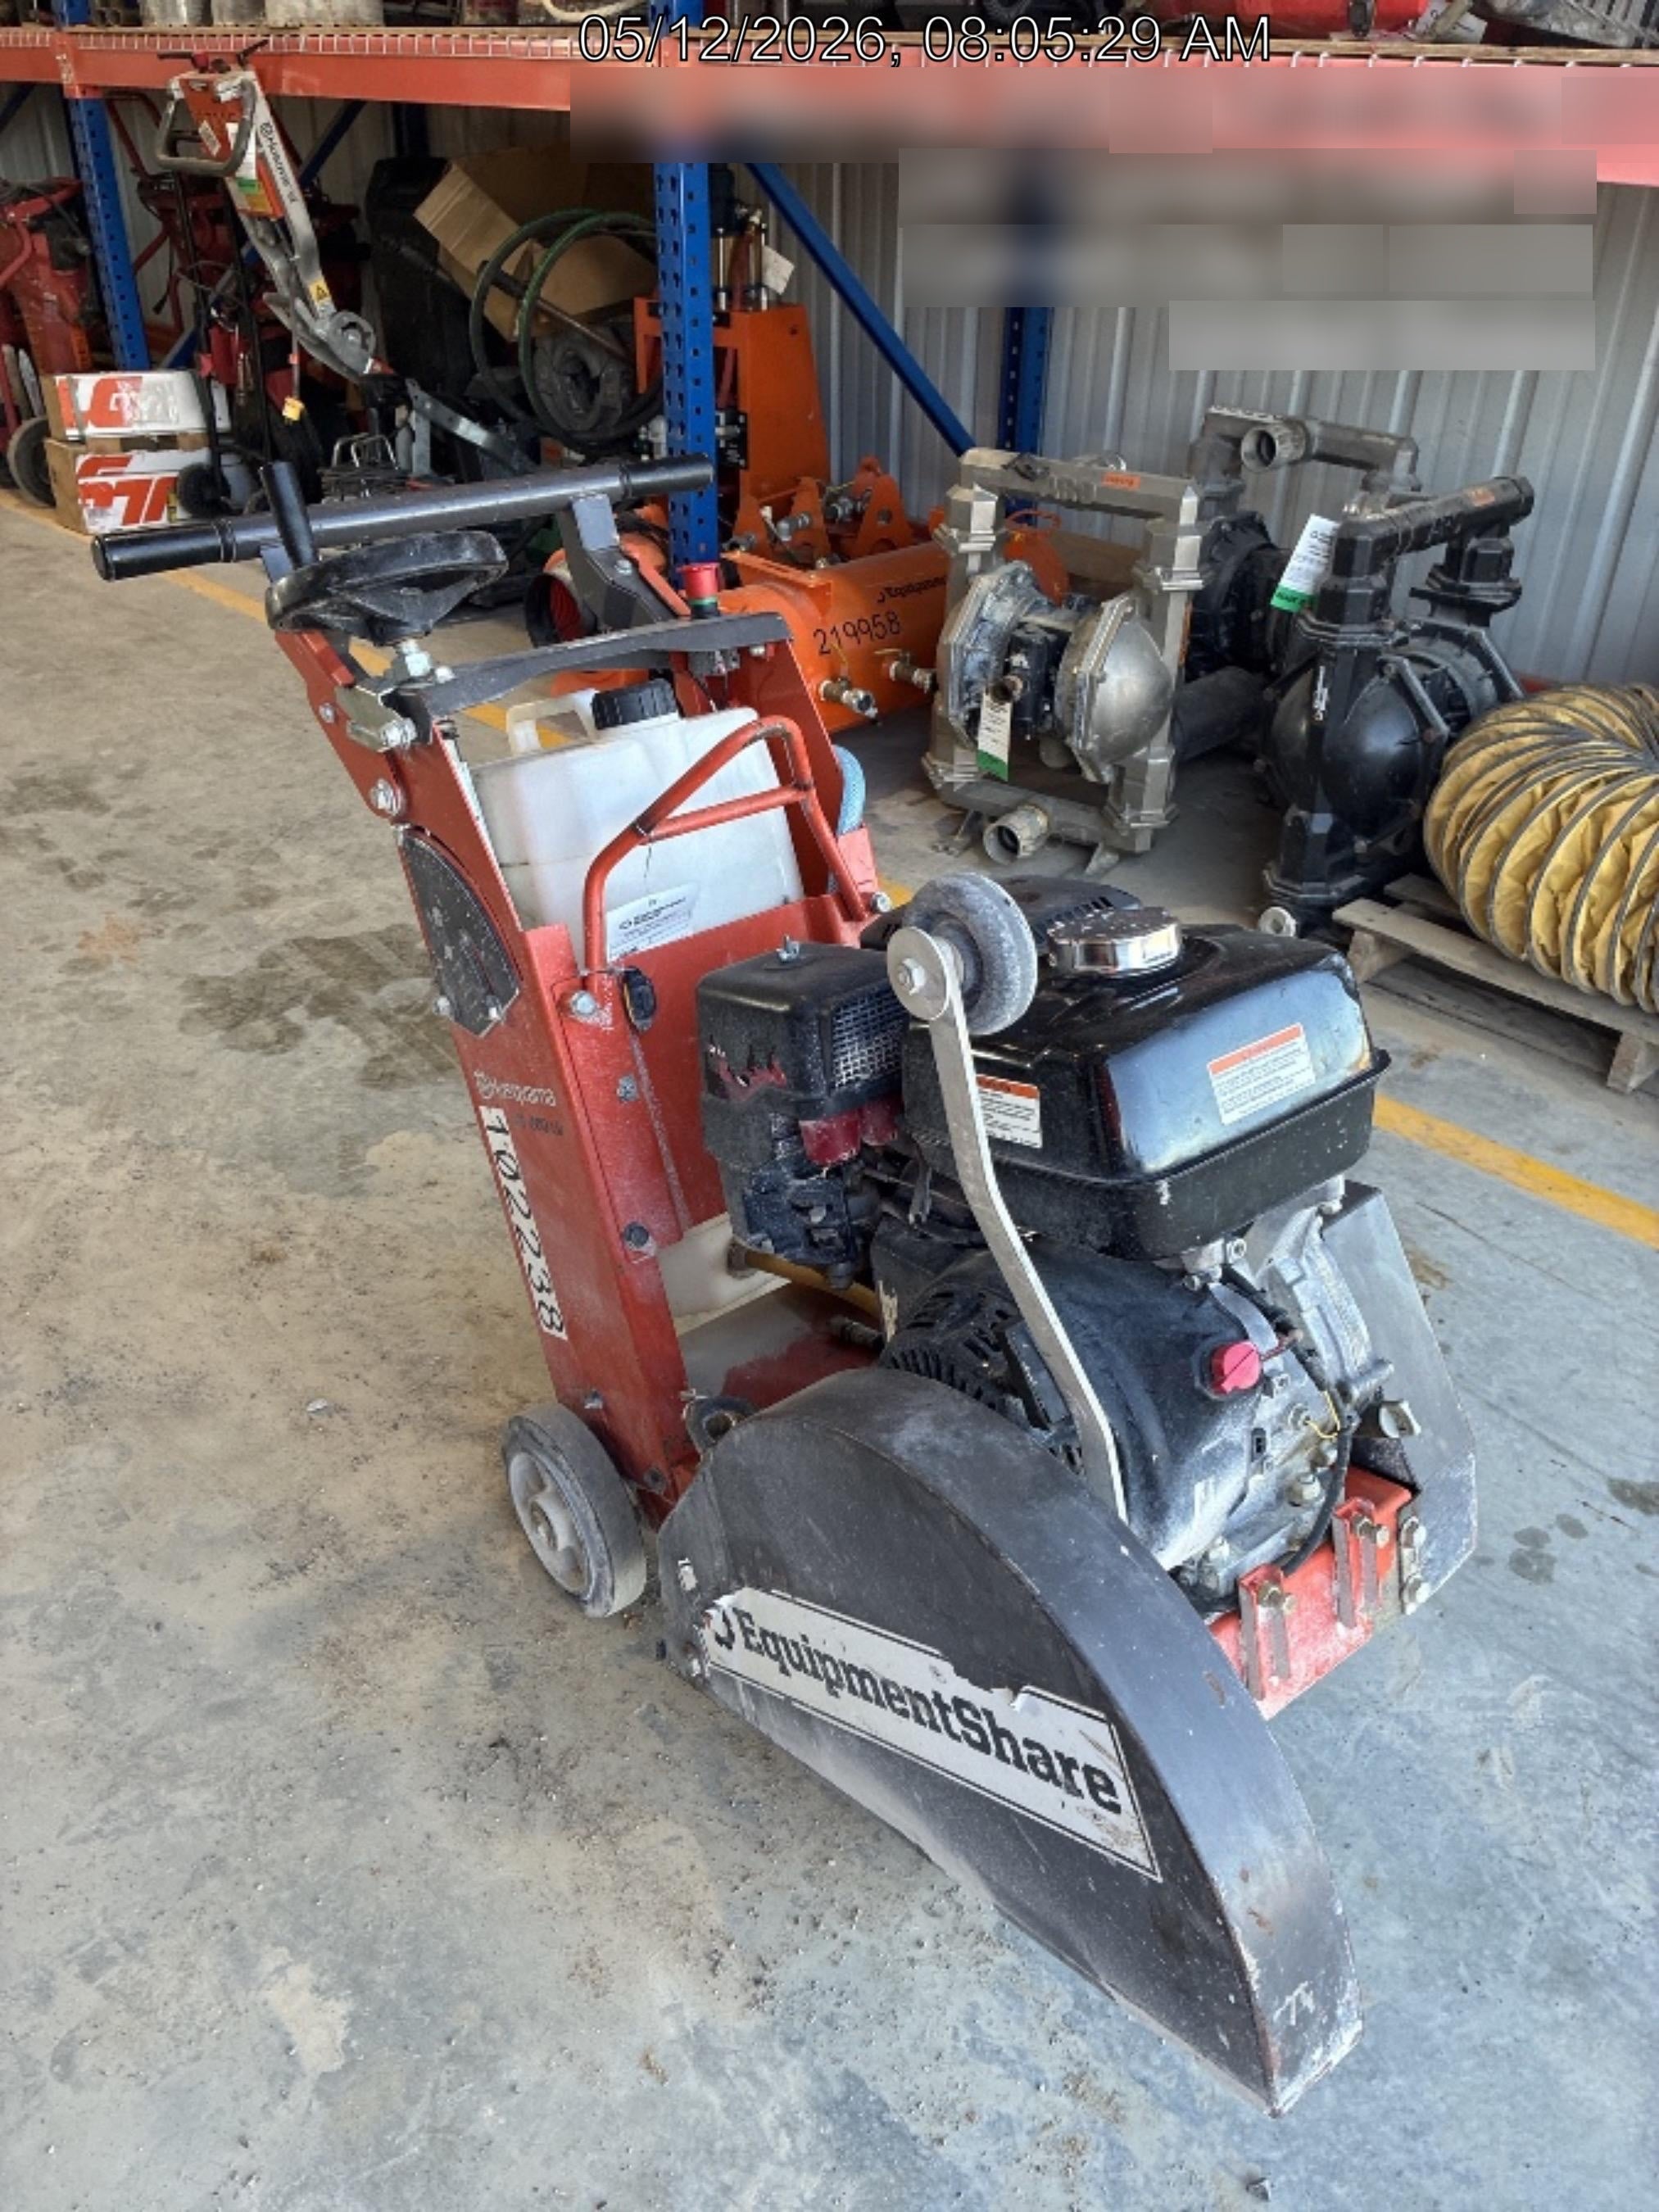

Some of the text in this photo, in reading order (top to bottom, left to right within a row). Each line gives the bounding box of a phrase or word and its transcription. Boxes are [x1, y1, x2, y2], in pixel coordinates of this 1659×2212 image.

[813, 610, 900, 656] 219958
[485, 1115, 565, 1334] 102238
[732, 1607, 1122, 1815] EquipmentShare
